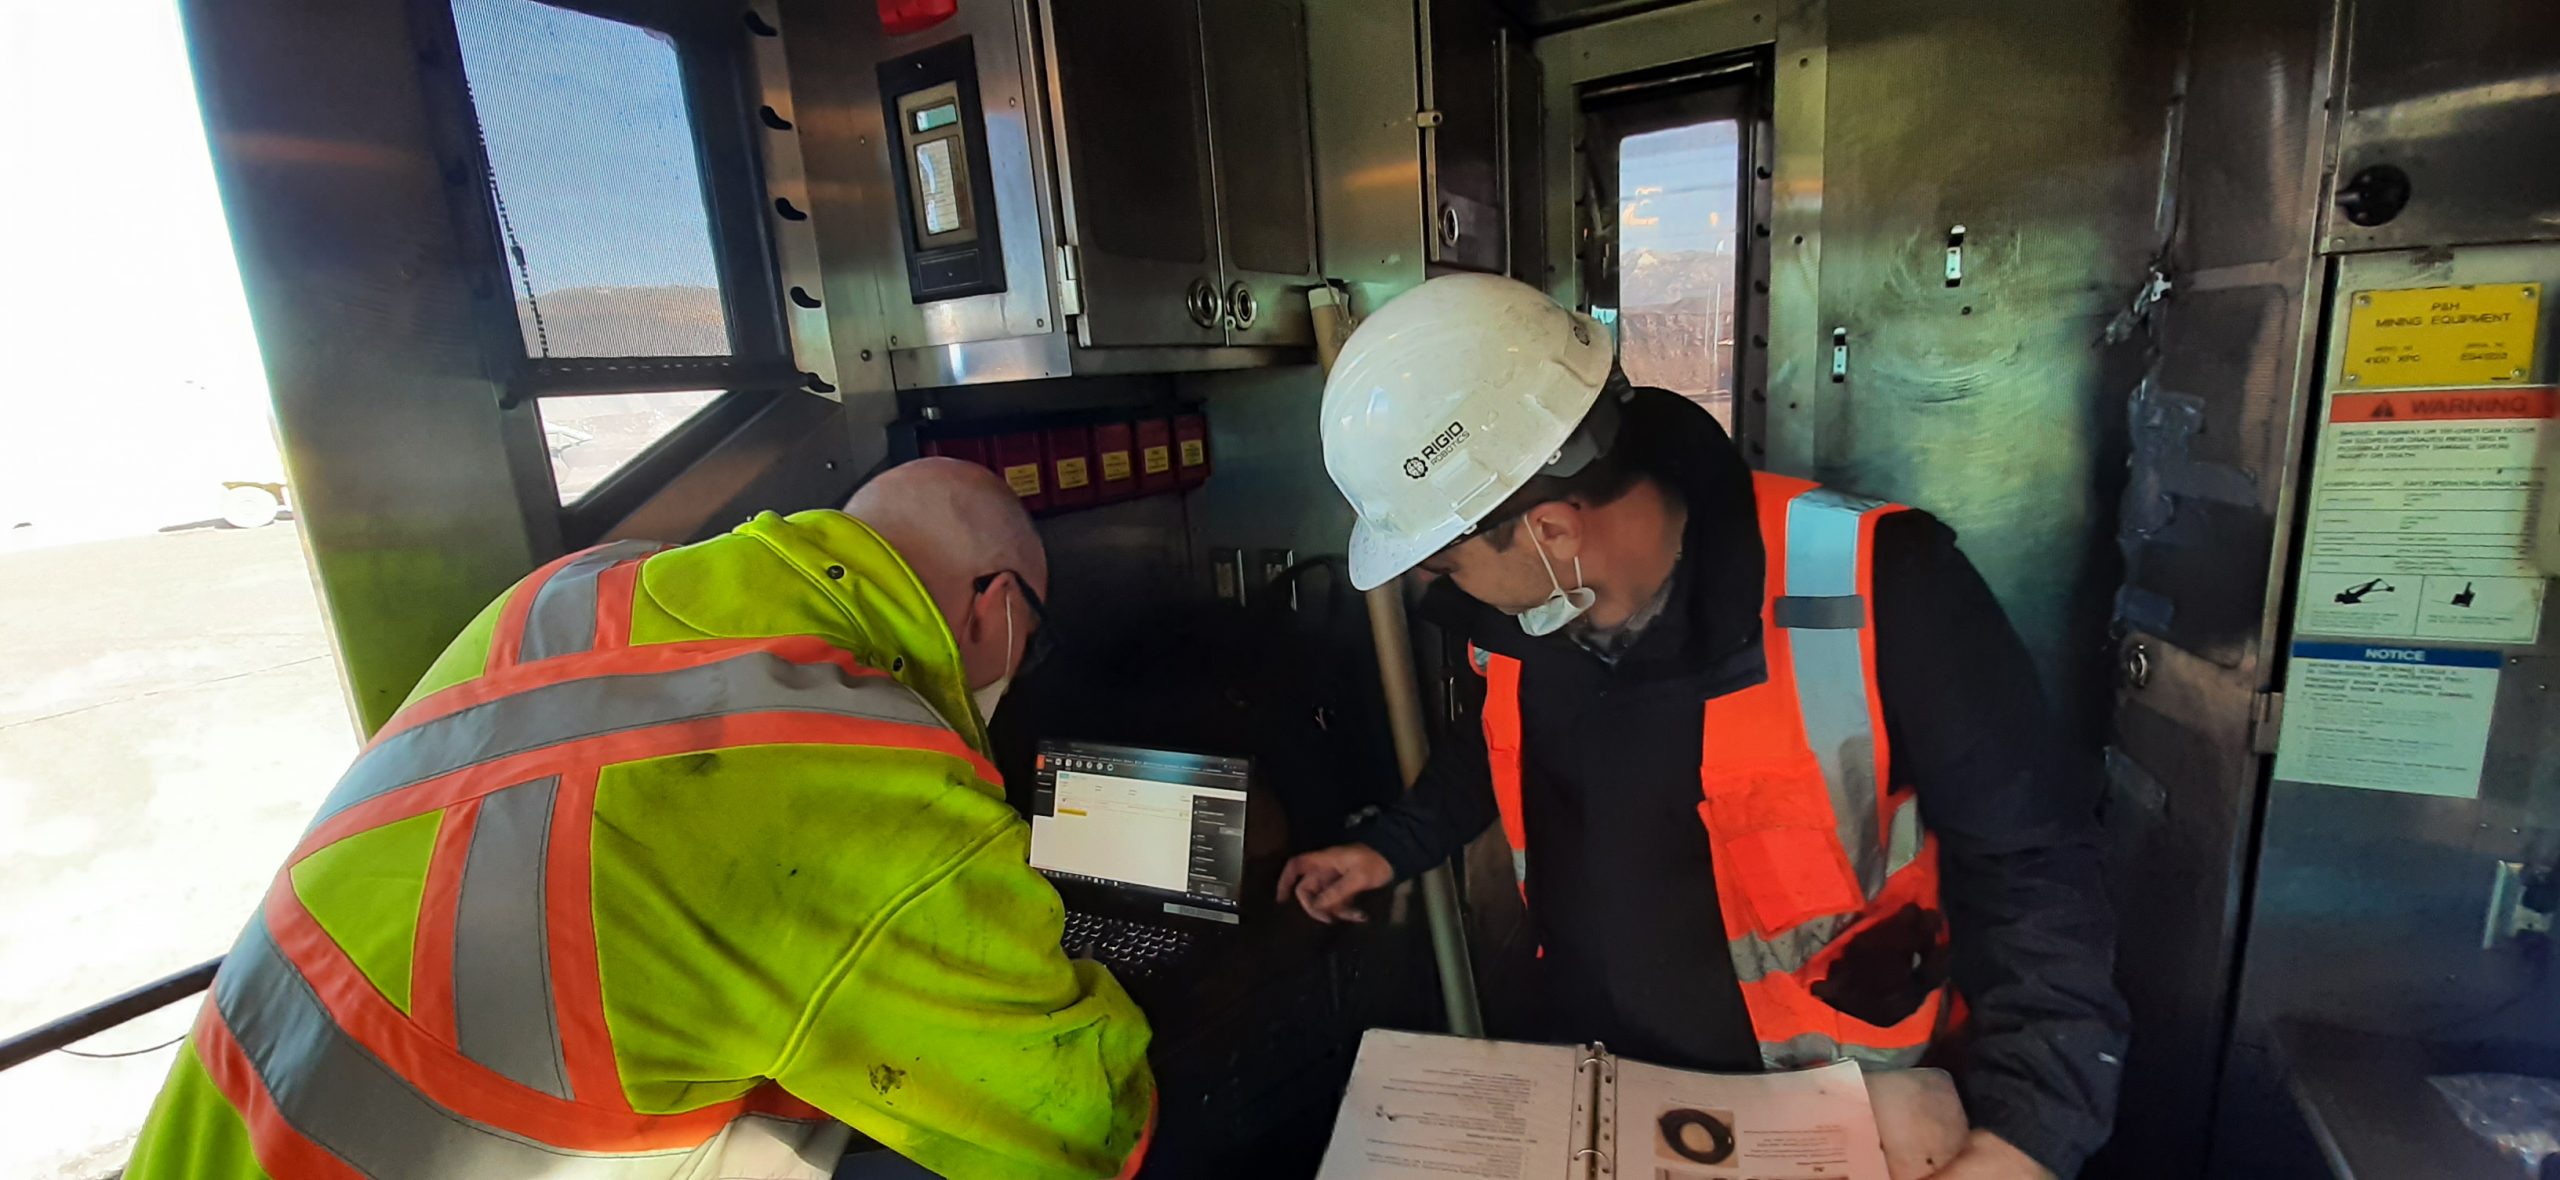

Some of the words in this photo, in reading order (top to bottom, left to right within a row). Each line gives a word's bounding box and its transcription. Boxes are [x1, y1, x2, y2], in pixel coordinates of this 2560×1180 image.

[2376, 316, 2423, 328] MINING
[2431, 312, 2512, 325] EQUIPMENT
[2411, 396, 2528, 414] WARNING
[1421, 421, 1464, 460] RIGID
[1430, 430, 1470, 466] ROBOTICS
[2365, 648, 2427, 662] NOTICE
